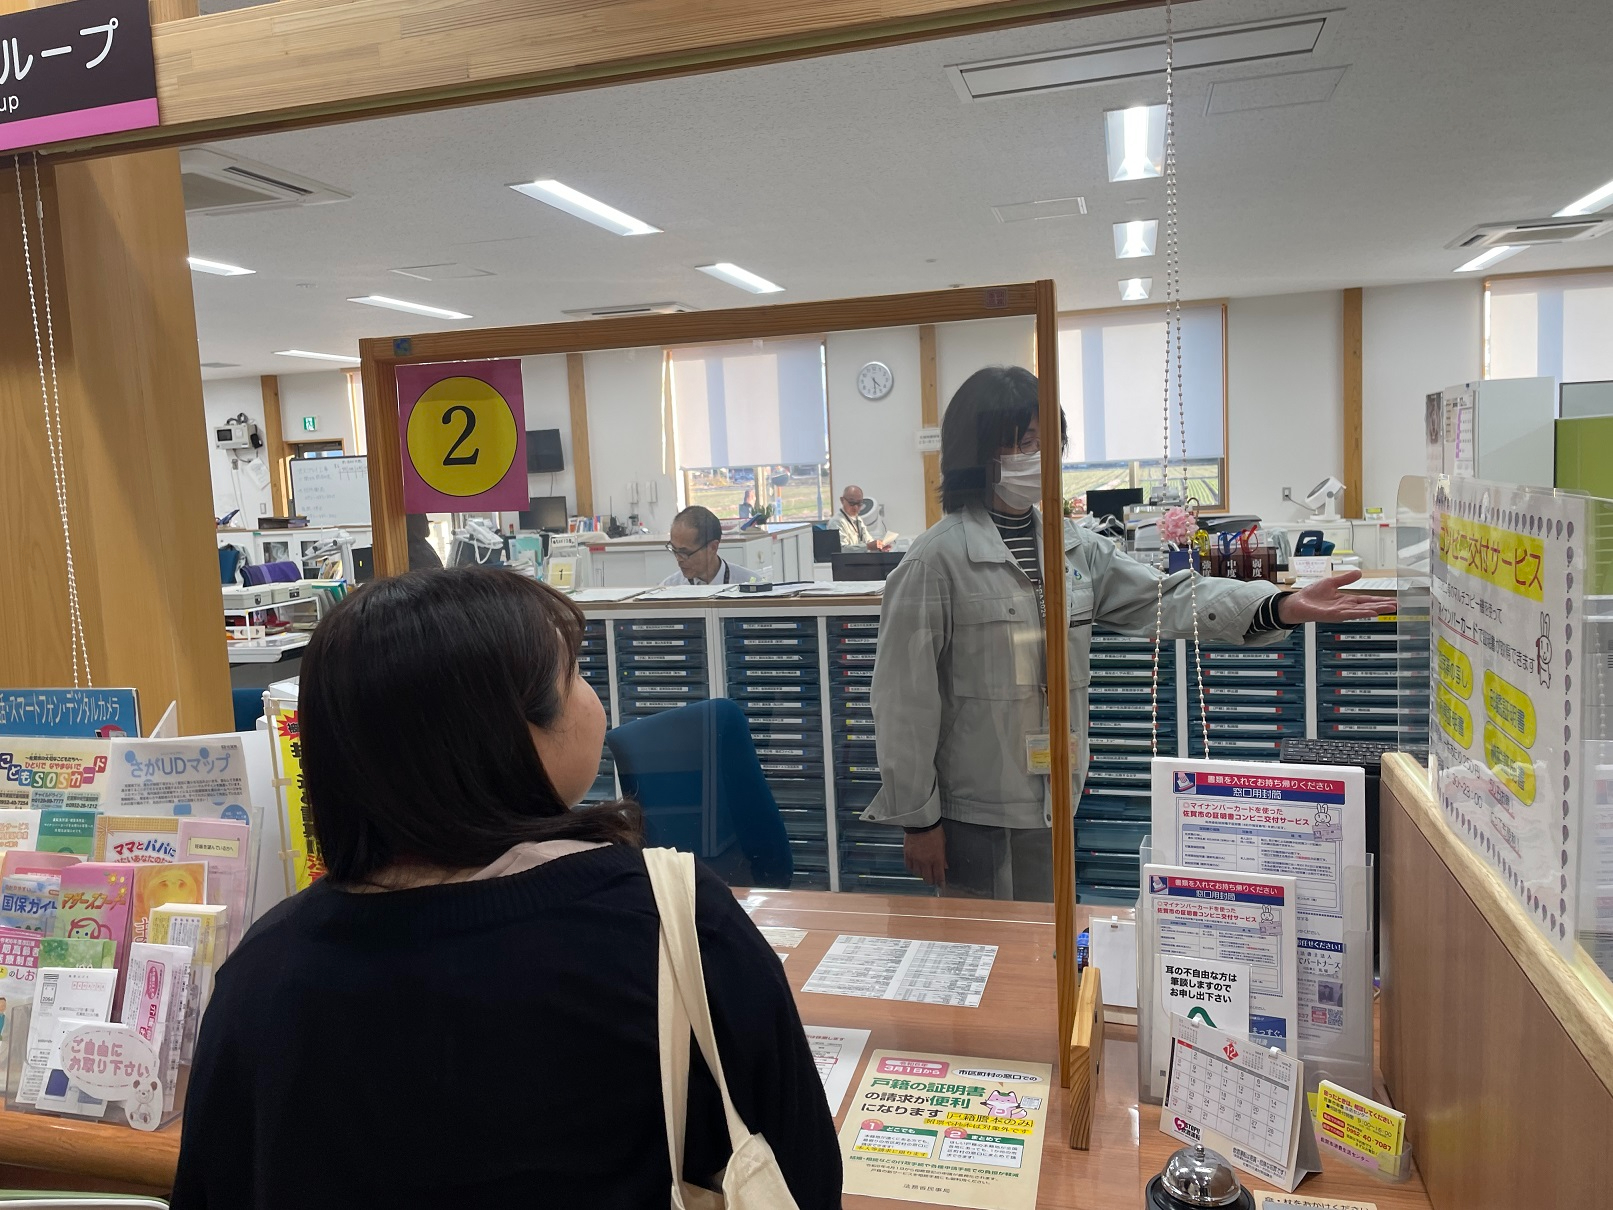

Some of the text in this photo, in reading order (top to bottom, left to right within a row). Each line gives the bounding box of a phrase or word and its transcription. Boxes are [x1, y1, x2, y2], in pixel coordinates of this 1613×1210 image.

[0, 17, 119, 85] ループ
[441, 405, 480, 466] 2
[1440, 526, 1543, 592] コンビニ交付サービス
[1227, 560, 1236, 578] 中度
[130, 752, 231, 778] さがUDマップ
[1207, 775, 1333, 790] 書類を入れてお持ち帰りください
[1232, 787, 1282, 800] 窓口用封筒
[1183, 810, 1310, 826] 佐賀市の証明書コンビニ交付サービス
[113, 839, 177, 858] ママとパパに
[1175, 879, 1278, 895] 書類を入れてお持ち帰りください
[61, 892, 127, 911] マザーズコーナー
[1195, 890, 1236, 901] 窓口用封筒
[1157, 908, 1257, 923] 佐賀市の証明書コンビニ交付サービス
[1165, 965, 1238, 983] 耳の不自由な方は
[1170, 976, 1232, 993] 筆談しますので
[1169, 987, 1232, 1003] お申し出下さい
[70, 1038, 123, 1057] ご自由に
[1226, 1045, 1237, 1058] 12
[68, 1055, 151, 1078] お取り下さい
[884, 1065, 940, 1075] 3月1日から
[958, 1069, 1038, 1082] 市区町村の窓口での
[870, 1077, 987, 1098] 戸籍の証明書
[865, 1092, 971, 1110] の請求が便利
[861, 1103, 944, 1118] になります
[869, 1122, 875, 1130] 1
[949, 1130, 1002, 1143] 2 まとめて
